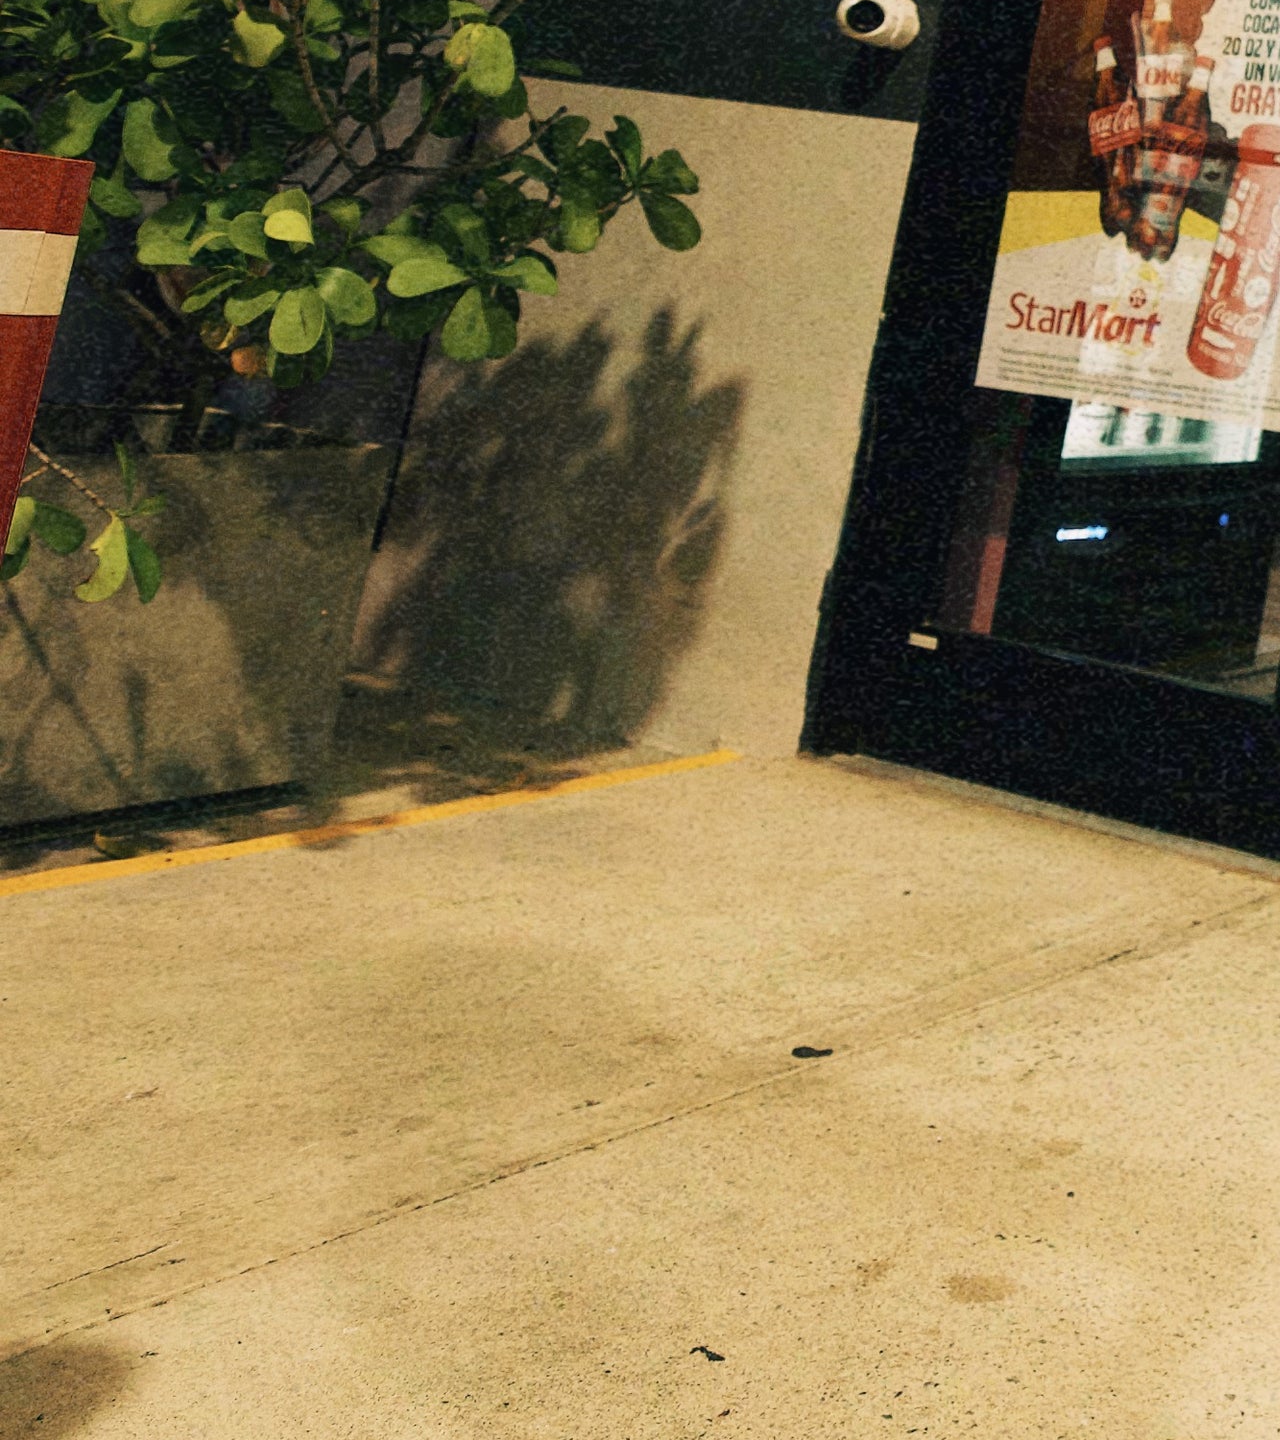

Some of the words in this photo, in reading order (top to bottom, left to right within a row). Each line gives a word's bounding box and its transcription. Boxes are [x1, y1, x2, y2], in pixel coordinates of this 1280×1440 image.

[1223, 36, 1242, 55] 20
[1245, 38, 1262, 58] OZ
[1266, 40, 1276, 58] Y
[1245, 62, 1266, 82] UN
[1006, 293, 1162, 346] StarMart
